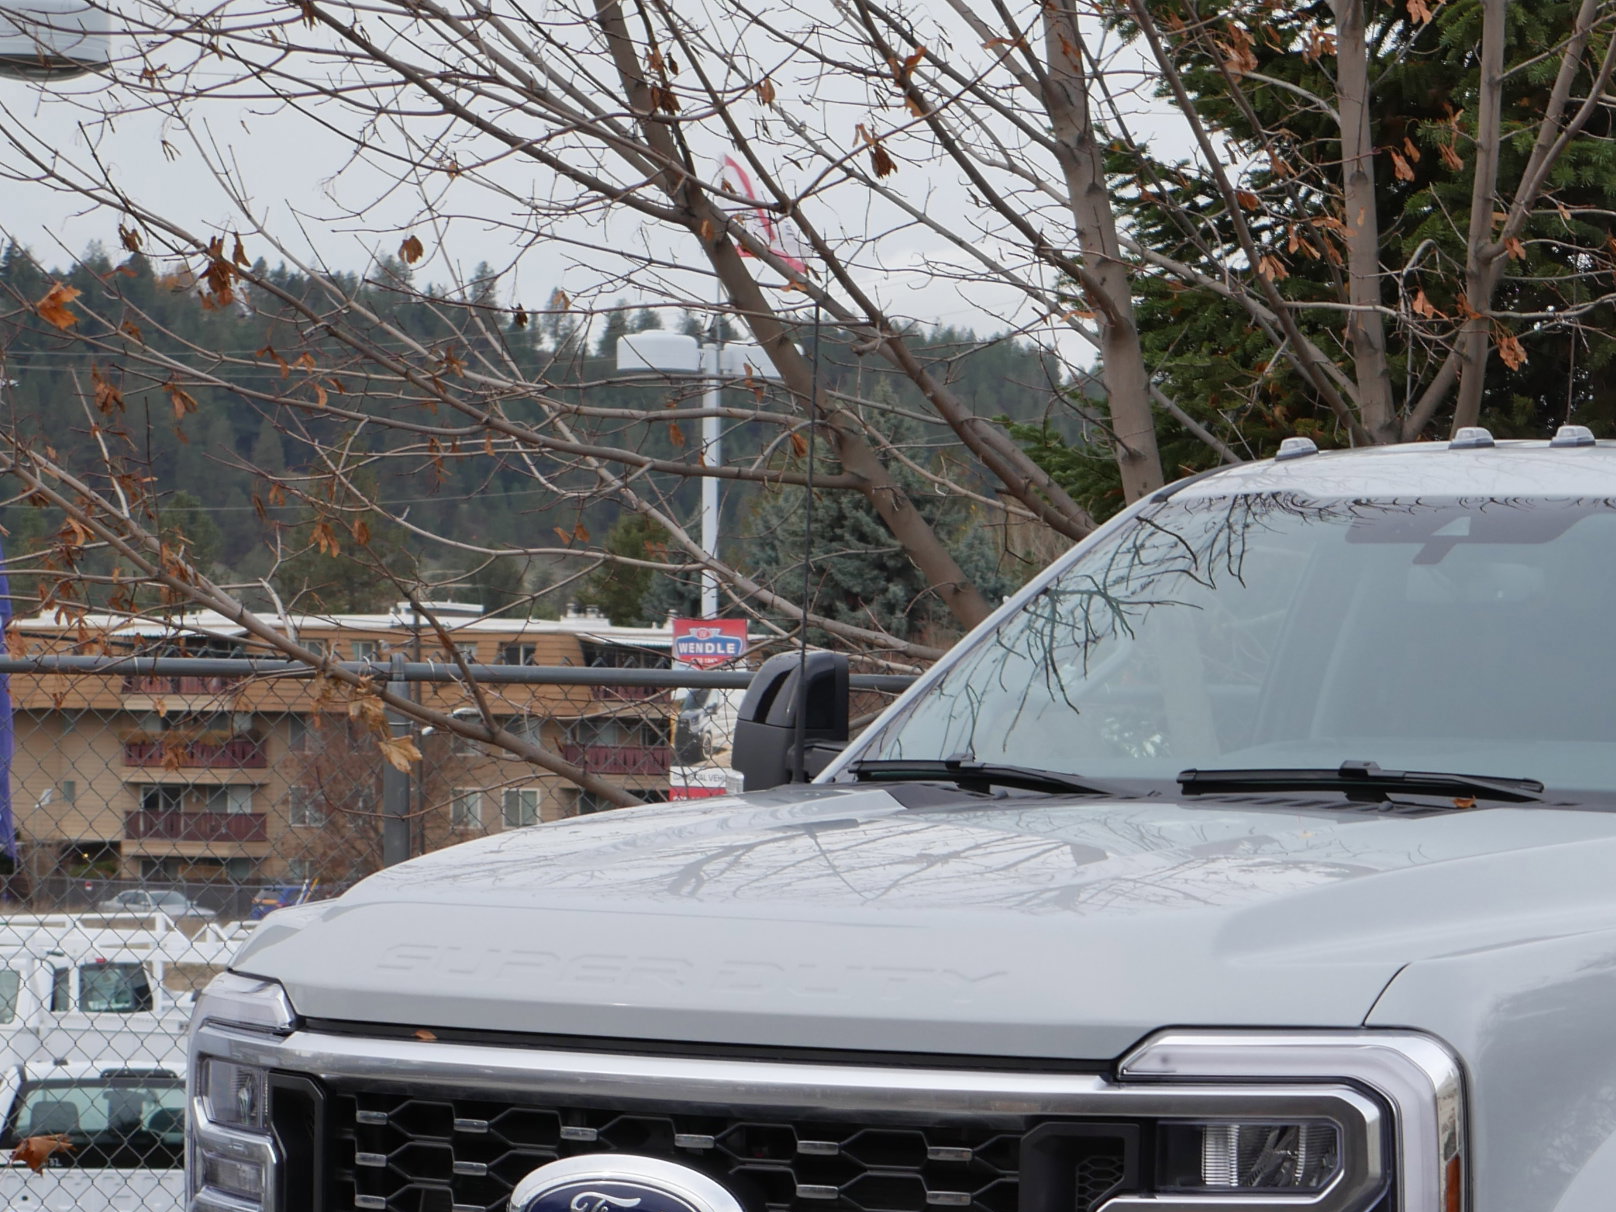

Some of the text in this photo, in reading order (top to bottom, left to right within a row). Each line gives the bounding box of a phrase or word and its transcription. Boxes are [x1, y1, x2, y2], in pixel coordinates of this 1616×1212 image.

[678, 642, 736, 654] WENDLE
[375, 943, 1010, 1004] SUPER DUTY
